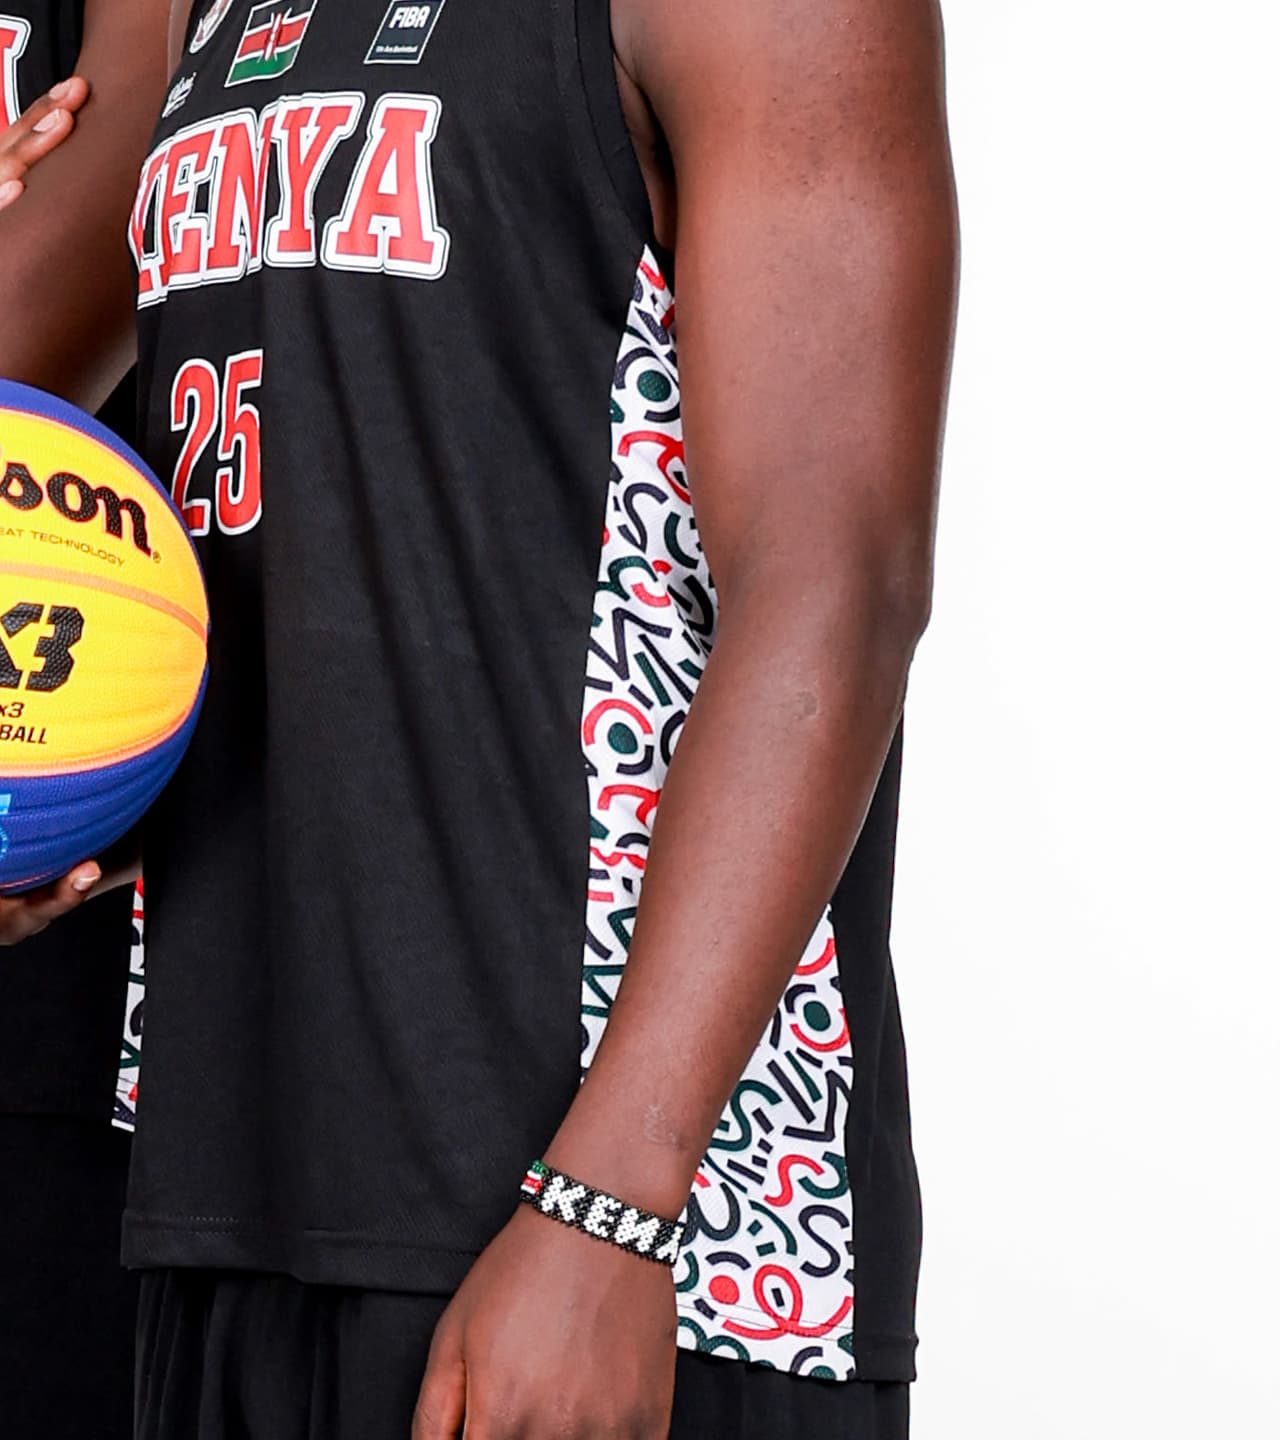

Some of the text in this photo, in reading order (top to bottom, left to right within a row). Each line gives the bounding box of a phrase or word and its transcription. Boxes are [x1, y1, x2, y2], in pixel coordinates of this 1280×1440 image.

[388, 5, 431, 29] FIBA
[169, 348, 265, 537] 25
[30, 530, 126, 568] TECHNOLOGY
